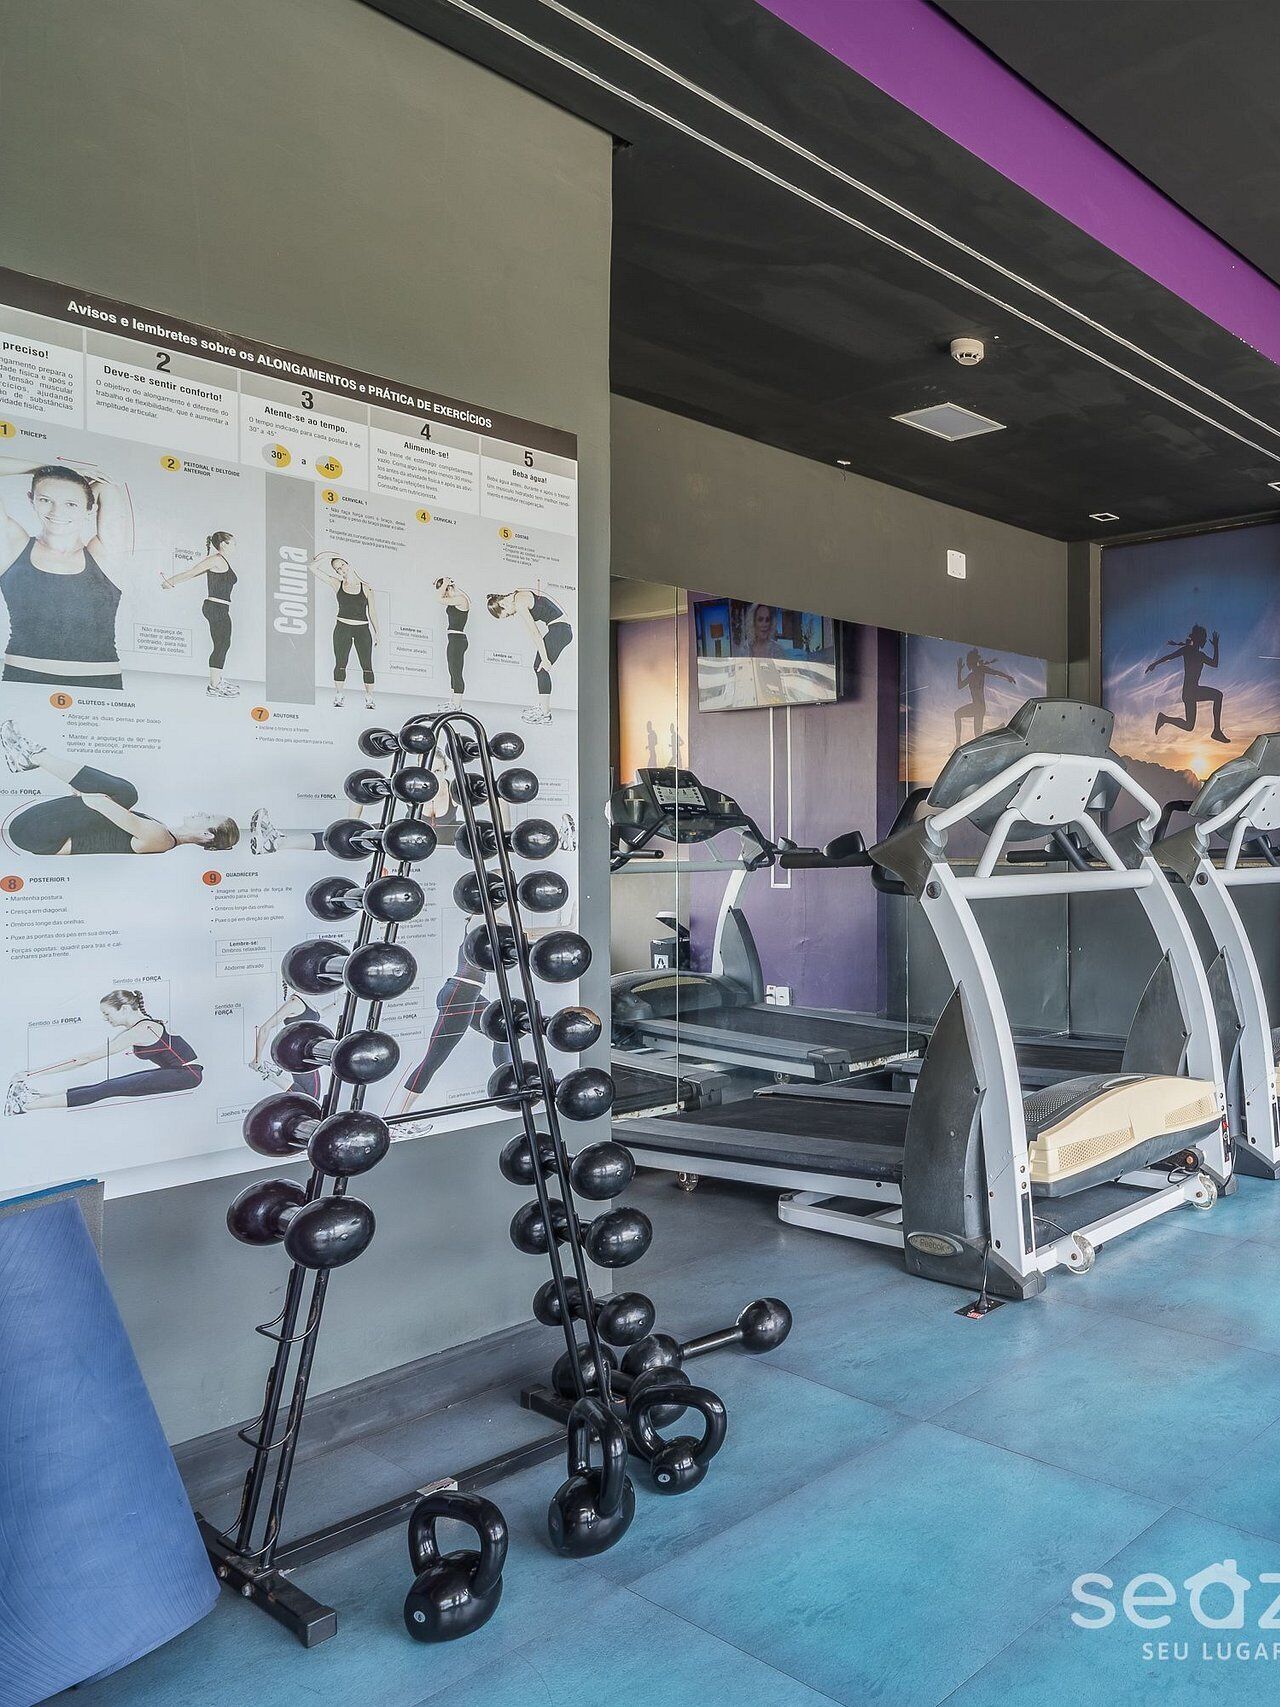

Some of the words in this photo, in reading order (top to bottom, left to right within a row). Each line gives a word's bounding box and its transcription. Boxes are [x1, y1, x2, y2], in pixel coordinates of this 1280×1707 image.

[3, 341, 49, 359] preciso!
[67, 300, 117, 324] Avisos
[120, 317, 129, 327] e
[132, 318, 198, 346] lembretes
[200, 339, 237, 357] sobre
[239, 351, 255, 362] os
[257, 354, 357, 391] ALONGAMENTOS
[359, 384, 366, 393] e
[368, 384, 414, 406] PRÁTICA
[417, 398, 432, 411] DE
[433, 403, 493, 428] EXERCÍCIOS
[156, 352, 171, 373] 2
[38, 366, 66, 378] prepara
[40, 382, 73, 395] muscular
[104, 365, 146, 383] Deve-se
[148, 377, 177, 391] sentir
[180, 385, 222, 402] conforto!
[37, 389, 73, 403] ajudando
[103, 382, 130, 393] objetivo
[132, 387, 141, 395] do
[143, 391, 185, 406] alongamento
[220, 409, 229, 417] do
[301, 390, 314, 410] 3
[264, 406, 305, 423] Atente-se
[307, 417, 318, 426] ao
[320, 419, 348, 434] tempo.
[421, 424, 431, 440] 4
[404, 441, 449, 459] Alimente-se!
[168, 459, 175, 469] 2
[524, 451, 534, 467] 5
[184, 468, 211, 477] ANTERIOR
[512, 469, 528, 479] Beba
[530, 474, 547, 484] água!
[328, 492, 334, 501] 3
[273, 546, 308, 635] Coluna
[57, 695, 66, 706] 6
[257, 709, 263, 719] 7
[8, 879, 16, 890] 8
[210, 873, 217, 884] 9
[142, 975, 162, 983] FORÇA
[60, 1016, 82, 1025] FORÇA
